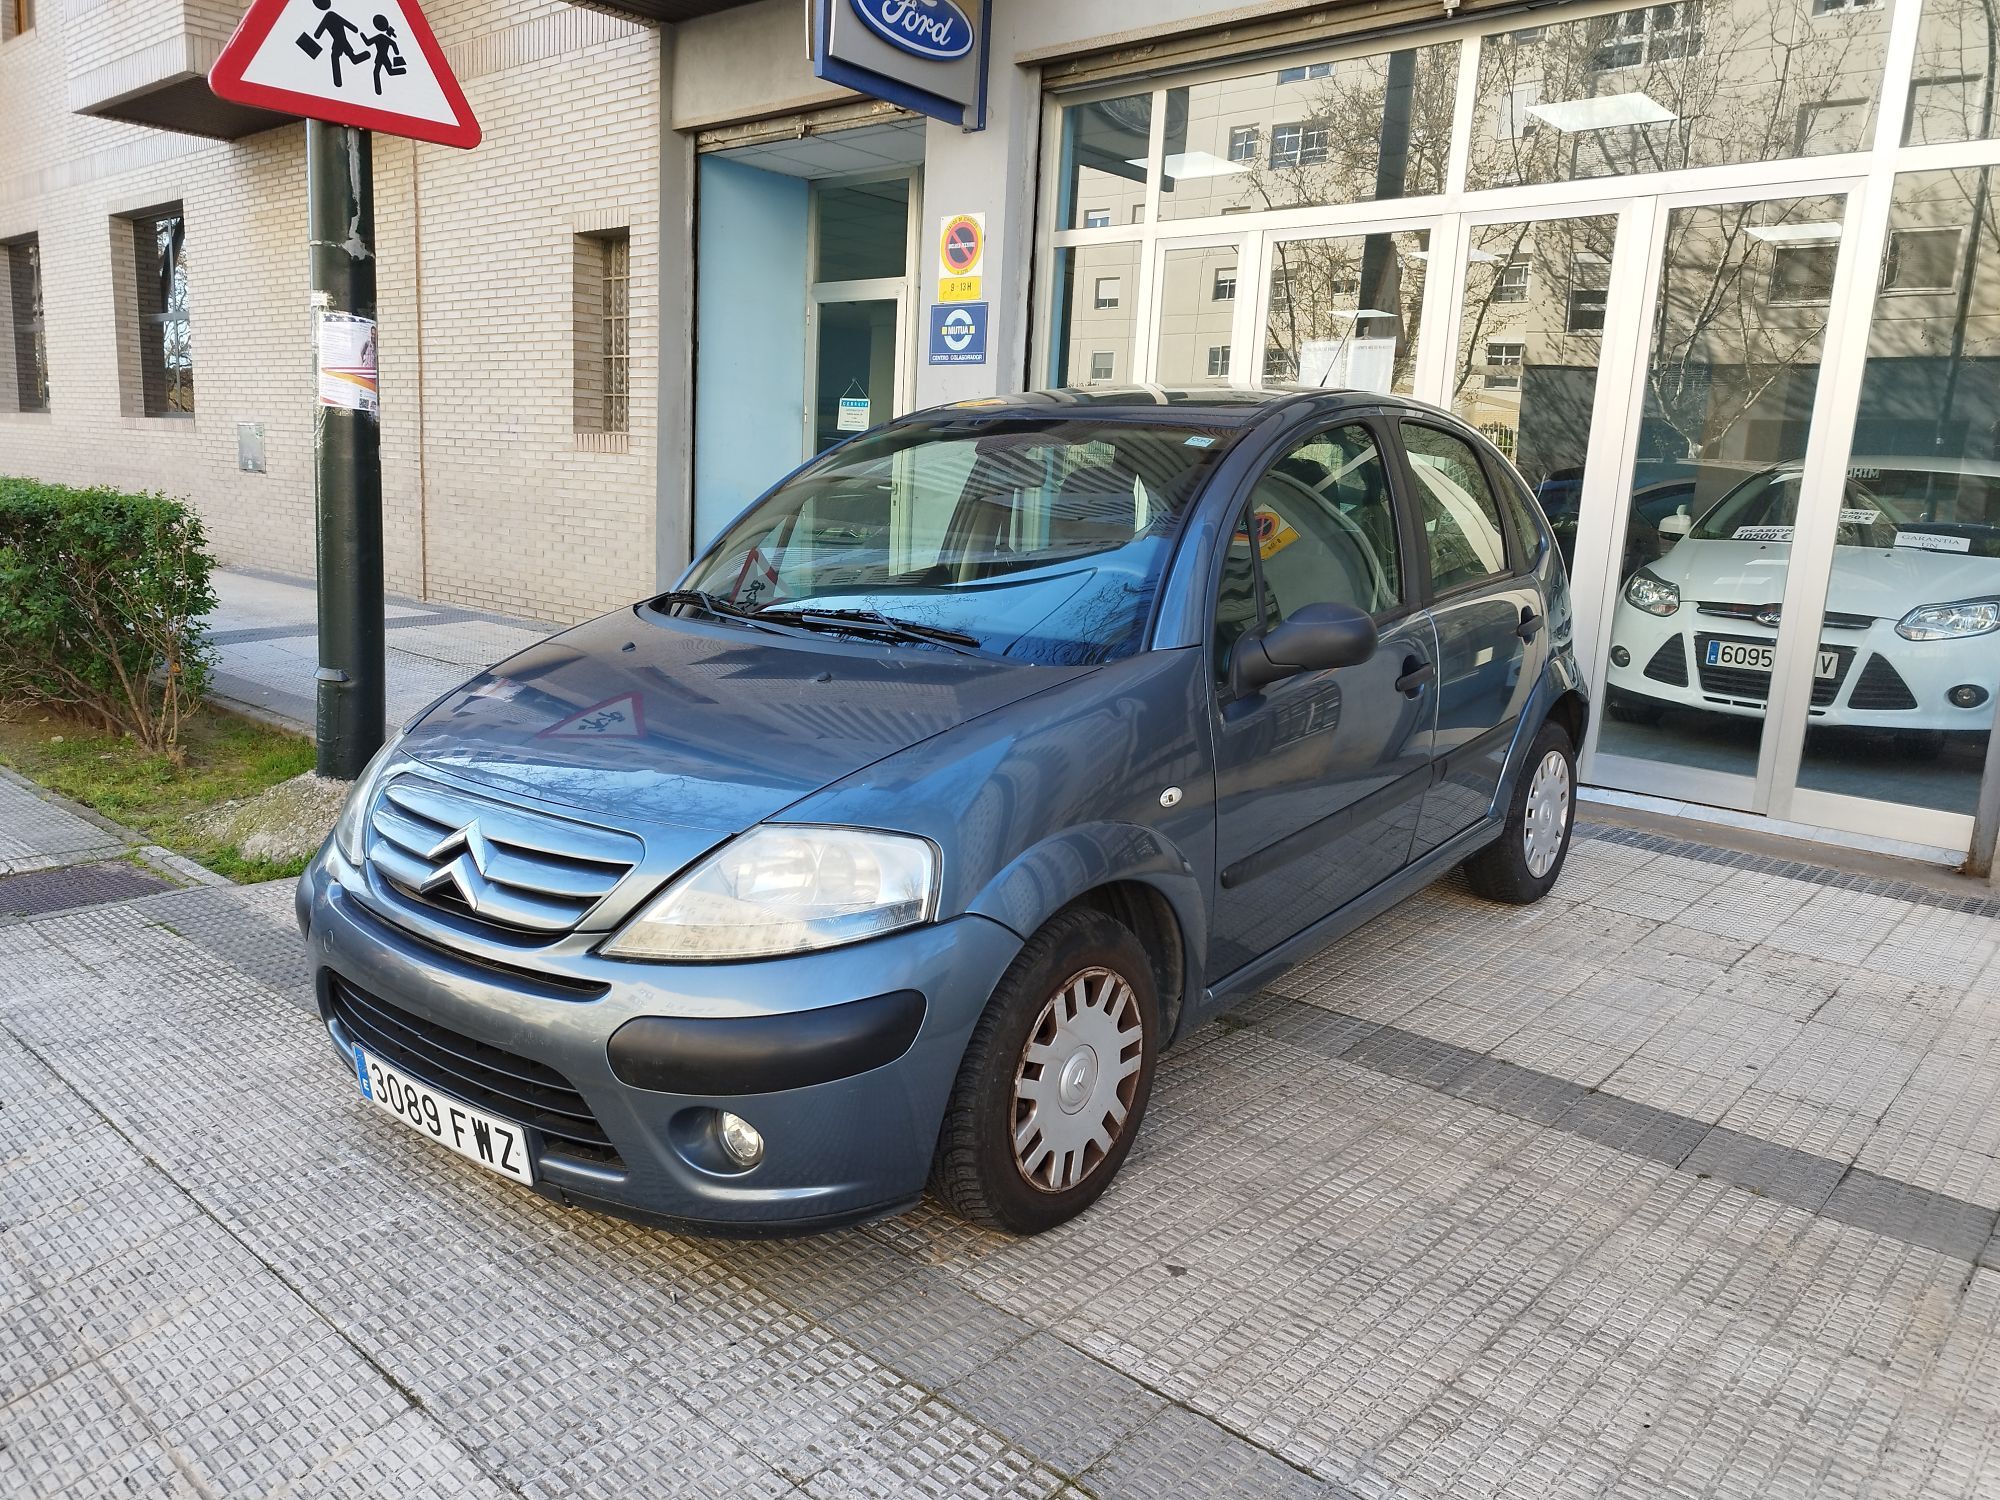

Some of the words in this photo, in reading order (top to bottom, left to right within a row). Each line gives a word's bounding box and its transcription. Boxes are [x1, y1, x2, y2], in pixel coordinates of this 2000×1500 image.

[881, 0, 953, 46] Ford
[947, 325, 969, 335] MUTUA
[1736, 531, 1777, 541] 10500
[1781, 532, 1792, 540] €
[1721, 645, 1773, 668] 6095
[363, 1077, 370, 1091] E
[371, 1062, 442, 1137] 3089
[449, 1106, 521, 1175] FWZ
